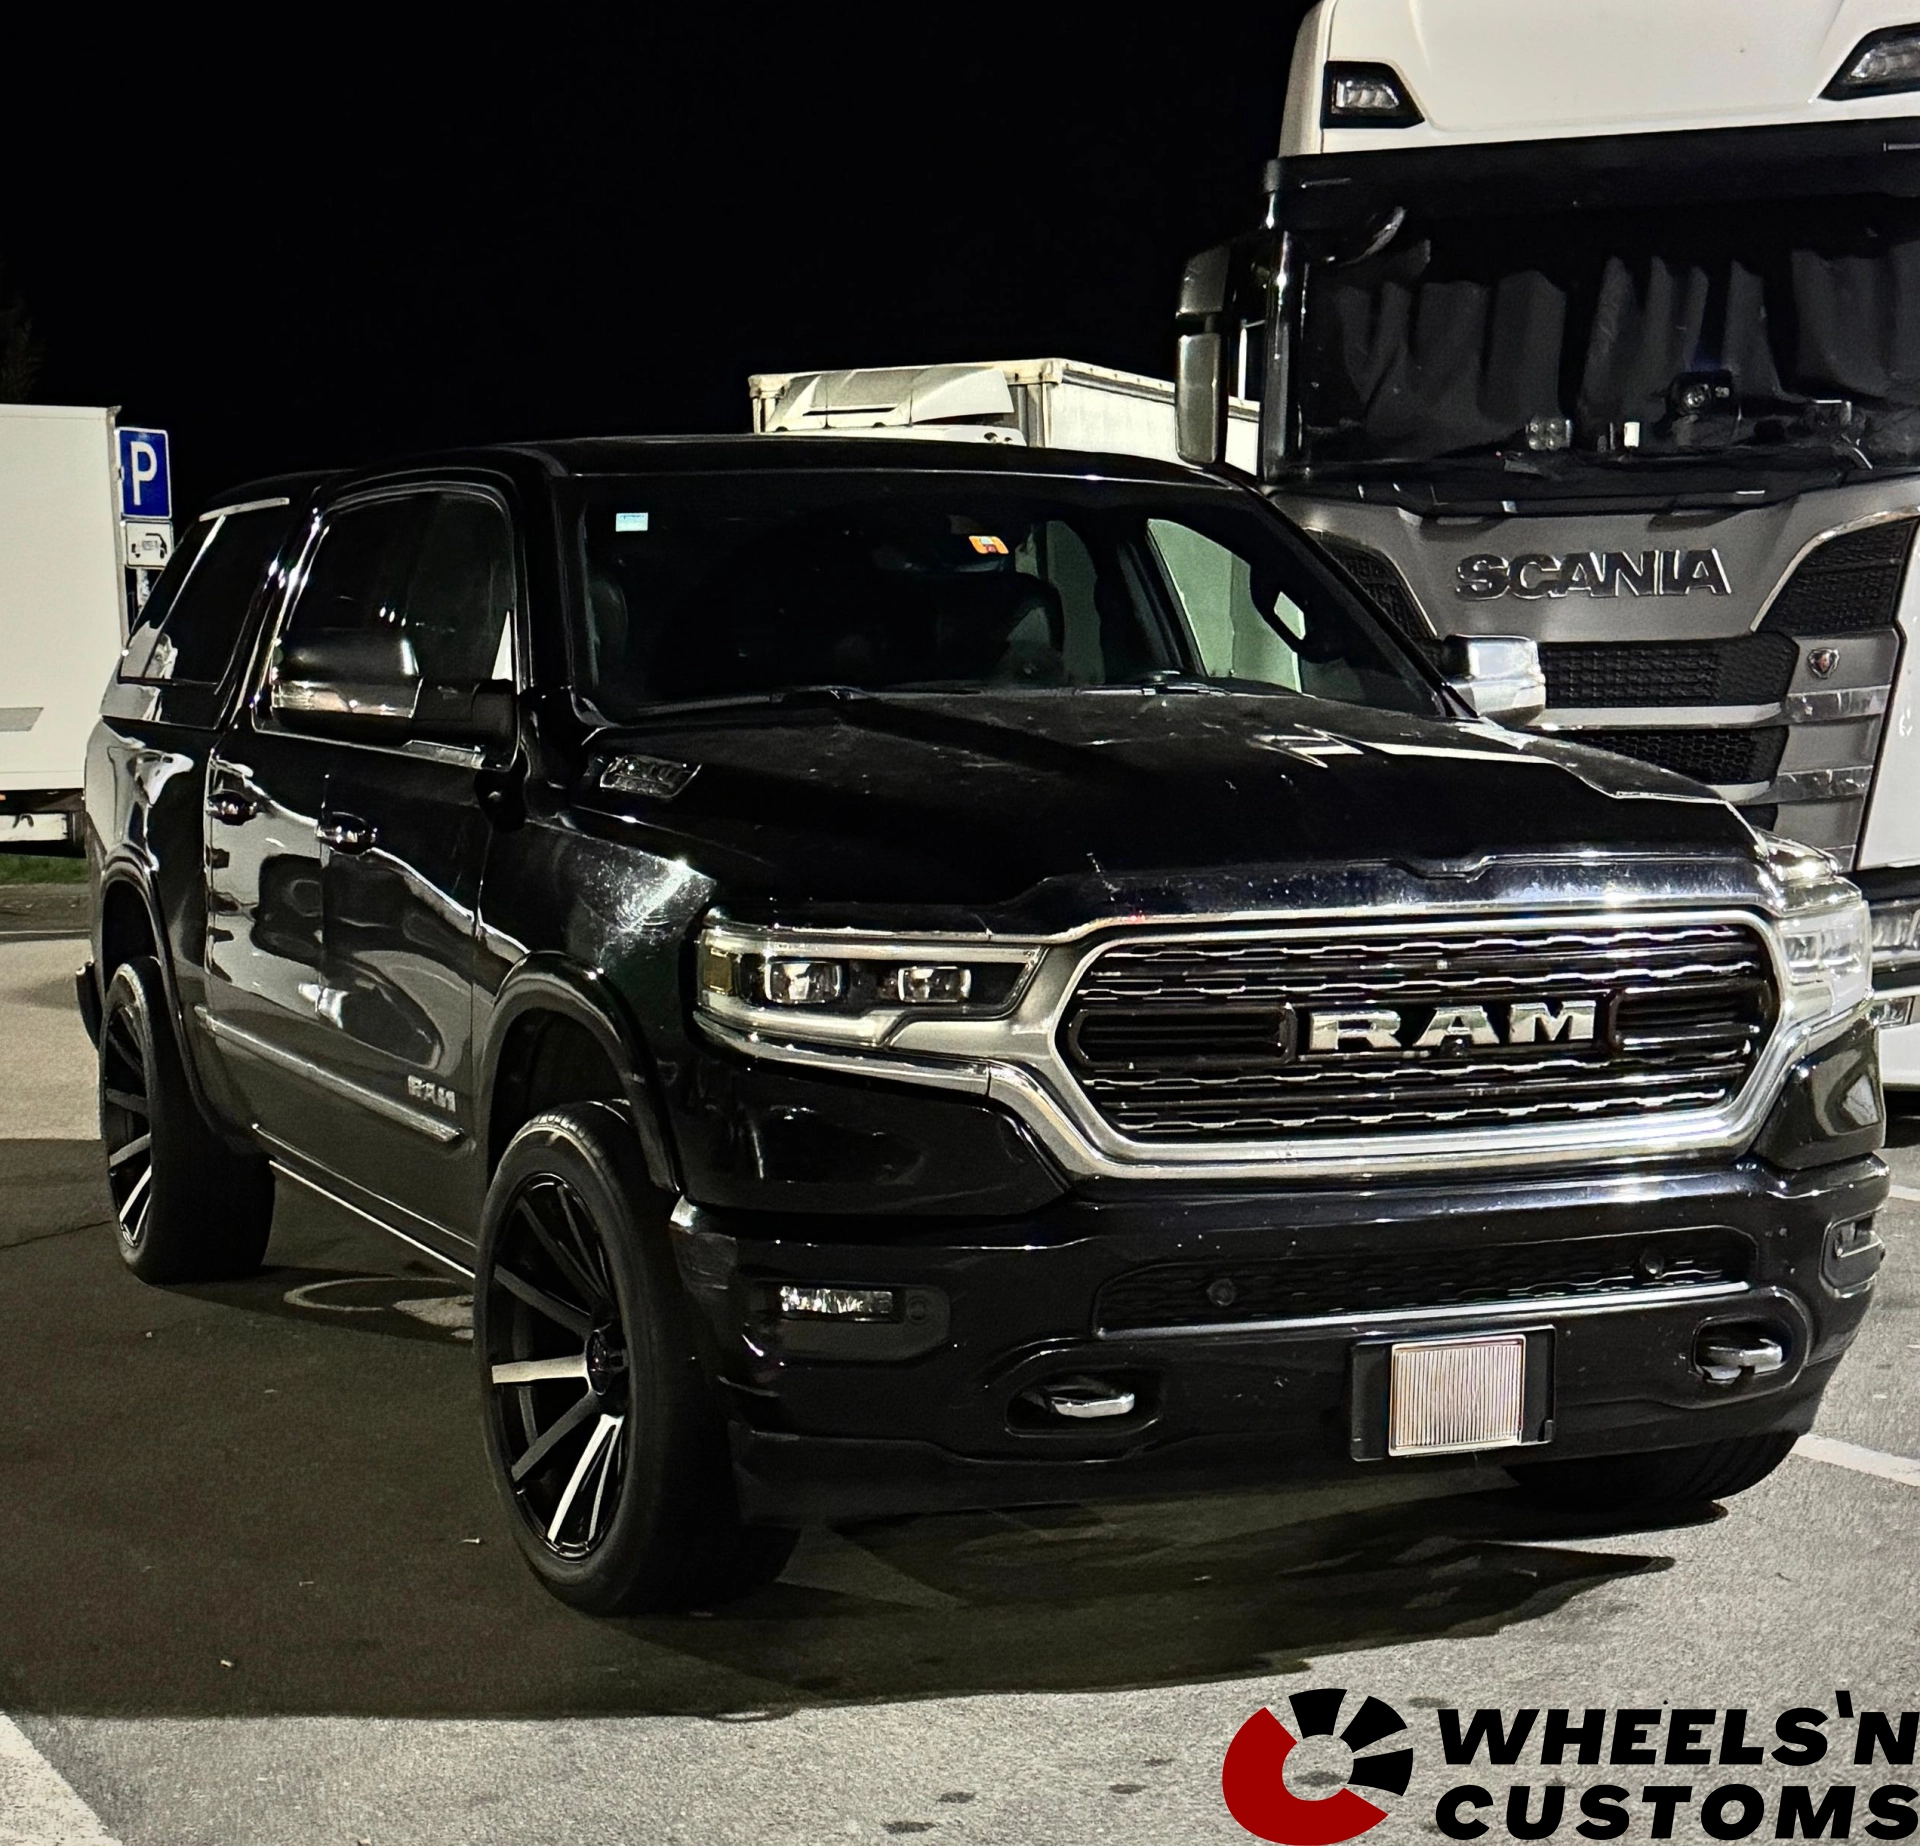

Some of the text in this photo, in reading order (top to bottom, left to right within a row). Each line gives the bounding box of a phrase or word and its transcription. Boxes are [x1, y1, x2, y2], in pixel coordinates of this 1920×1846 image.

[130, 441, 158, 506] P
[1456, 548, 1732, 600] SCANIA
[1308, 1000, 1597, 1052] RAM
[407, 1074, 456, 1113] RAM
